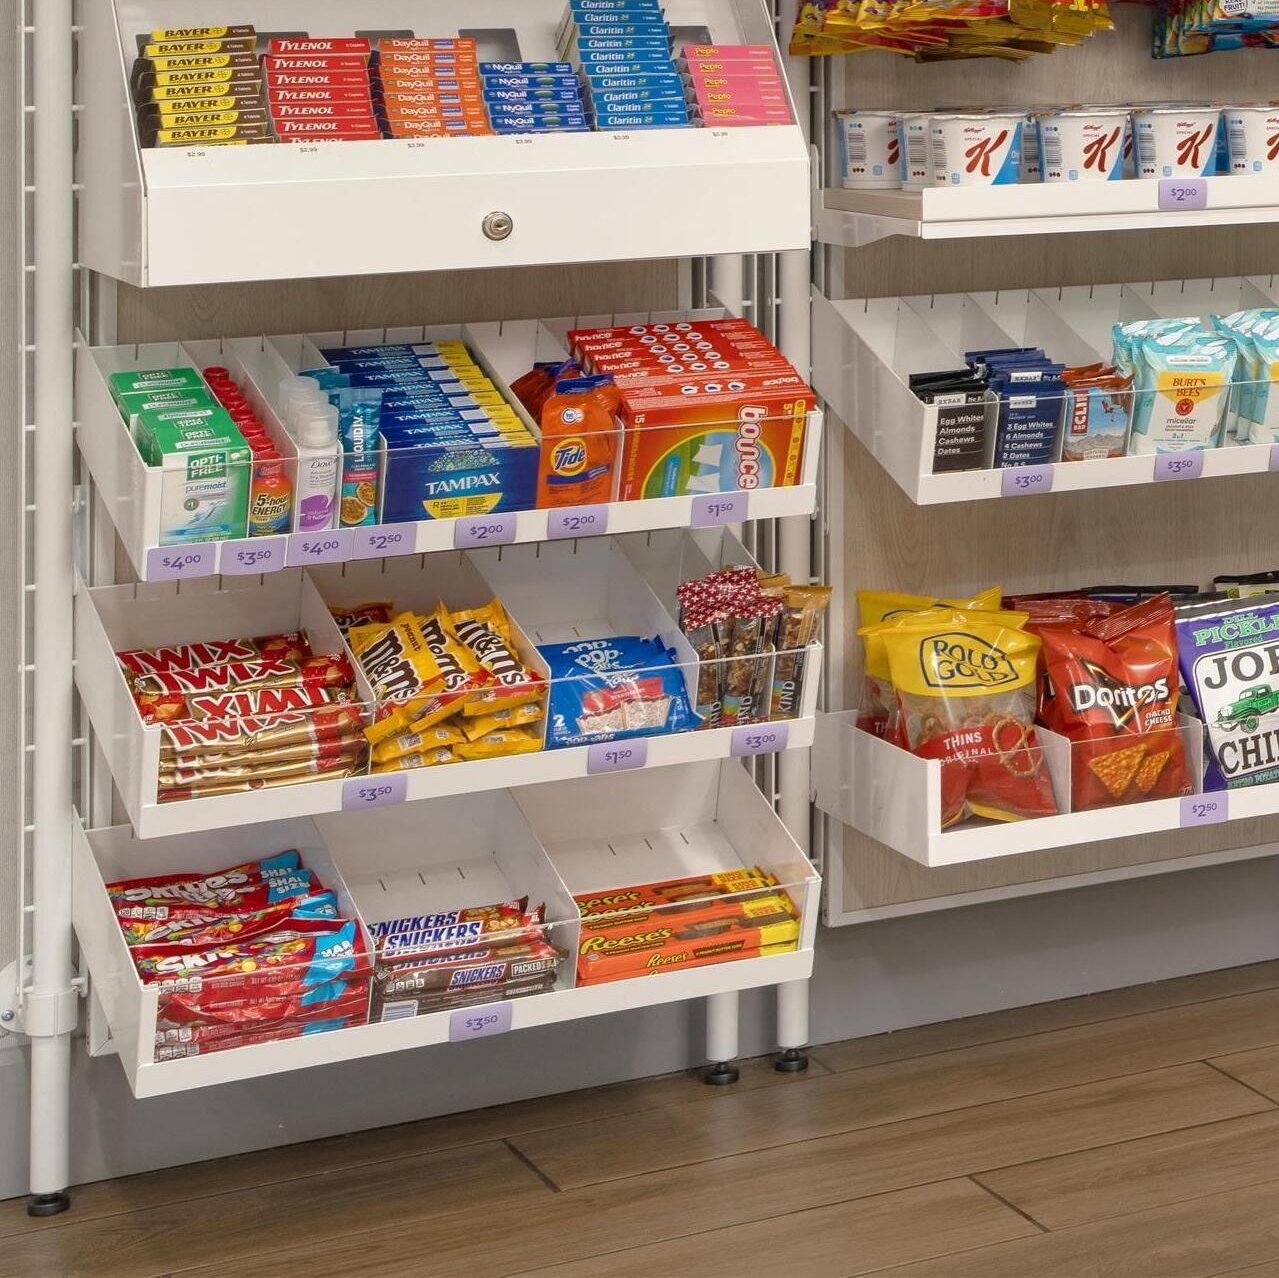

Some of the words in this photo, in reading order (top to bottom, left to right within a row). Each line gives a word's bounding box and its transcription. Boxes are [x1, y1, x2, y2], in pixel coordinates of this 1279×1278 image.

[581, 0, 614, 9] Claritin
[1223, 2, 1245, 11] FRUIT!
[164, 28, 210, 38] BAYER
[279, 40, 333, 51] TYLENOL
[392, 39, 429, 49] DayQuil
[493, 63, 522, 73] NyQuil
[940, 417, 954, 425] Egg
[957, 414, 984, 423] Whites
[1167, 416, 1196, 425] micellar
[940, 425, 976, 434] Almonds
[938, 436, 975, 444] Cashews
[736, 405, 768, 489] bounce
[937, 447, 960, 455] Dates
[553, 444, 586, 471] Tide
[190, 464, 226, 478] FREE
[425, 472, 501, 496] TAMPAX
[251, 503, 288, 516] ENERGY
[932, 640, 1000, 672] ROLD
[936, 659, 1010, 684] GOLD
[777, 679, 796, 713] KIND
[1074, 678, 1169, 712] Doritos
[1146, 708, 1170, 717] NACHO
[1145, 715, 1173, 726] CHEESE
[943, 732, 982, 751] THINS
[580, 927, 673, 955] Reese's
[646, 952, 687, 967] Reese's
[513, 961, 542, 974] PACKED
[451, 964, 505, 985] SNICKERS
